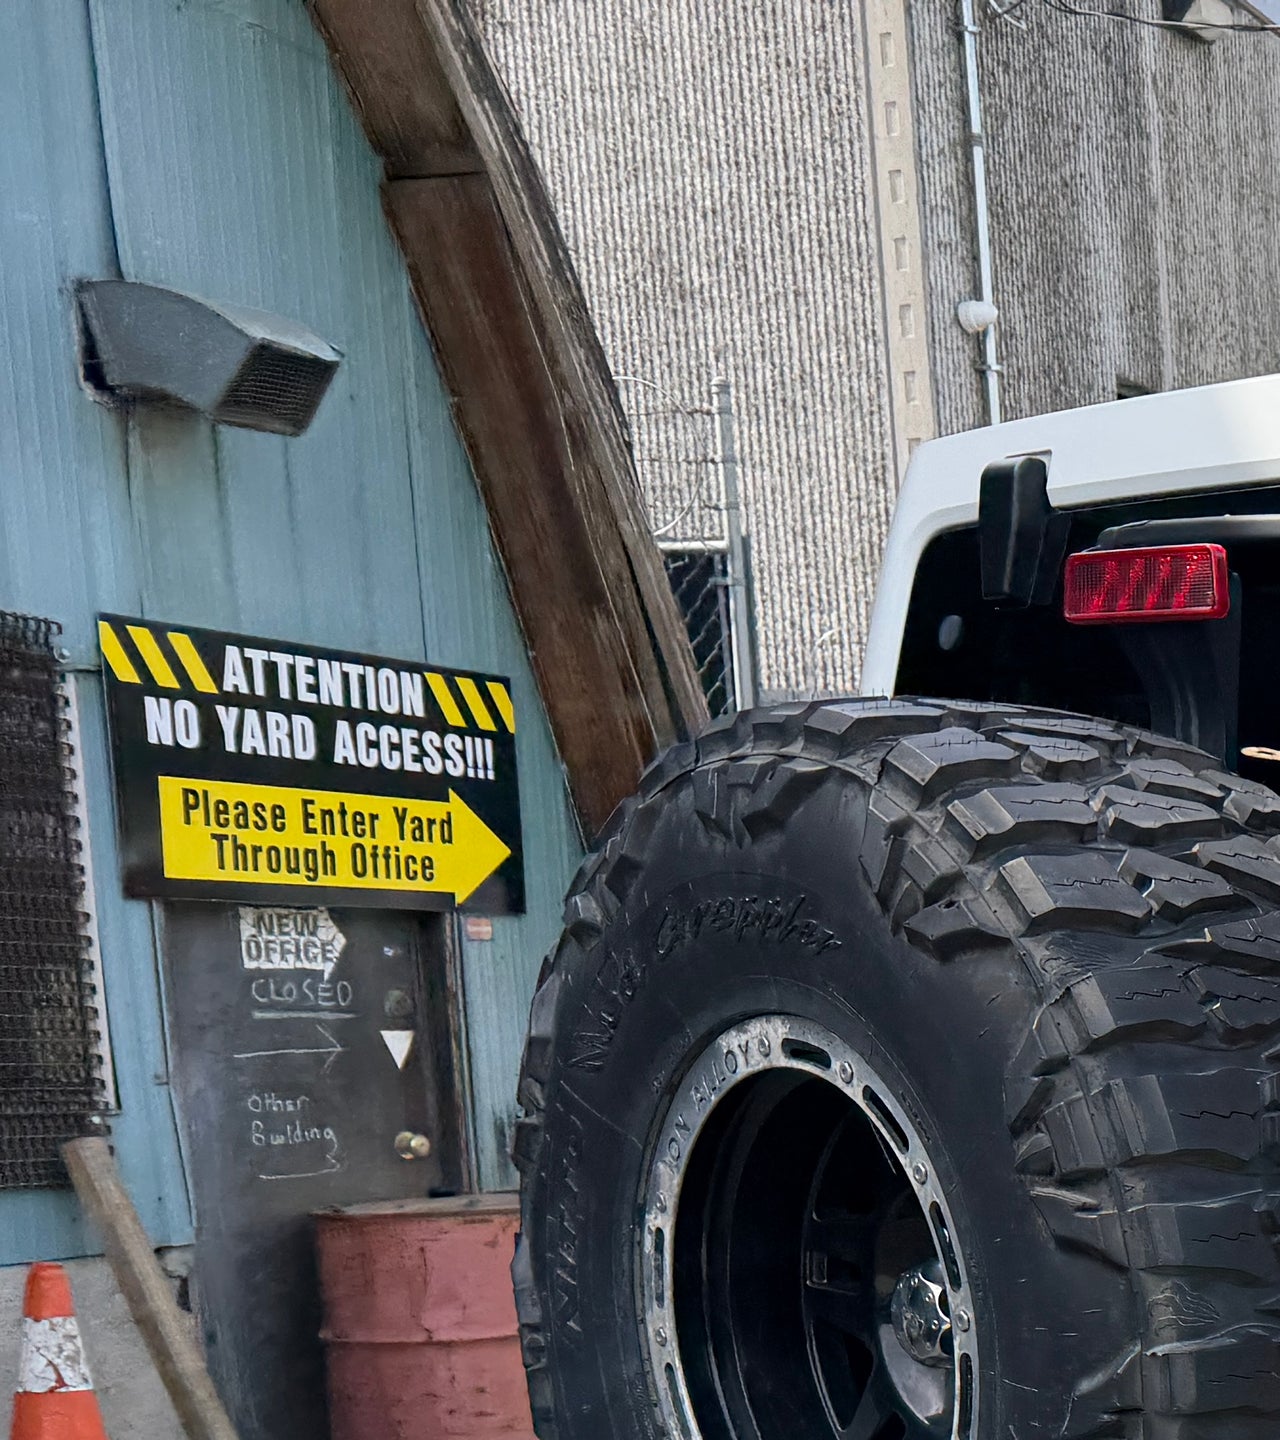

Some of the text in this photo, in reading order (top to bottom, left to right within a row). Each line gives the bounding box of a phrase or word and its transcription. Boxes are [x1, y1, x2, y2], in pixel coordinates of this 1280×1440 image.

[222, 644, 426, 718] ATTENTION
[144, 695, 496, 780] NO YARD ACCESS!!!
[181, 787, 454, 845] Please Enter Yard
[210, 833, 435, 883] Through Office
[254, 911, 318, 937] NEW
[244, 935, 337, 963] OFFICE
[251, 978, 353, 1007] CLOSED
[690, 1038, 752, 1112] ALLOY
[247, 1092, 310, 1114] Other
[251, 1120, 338, 1154] Building
